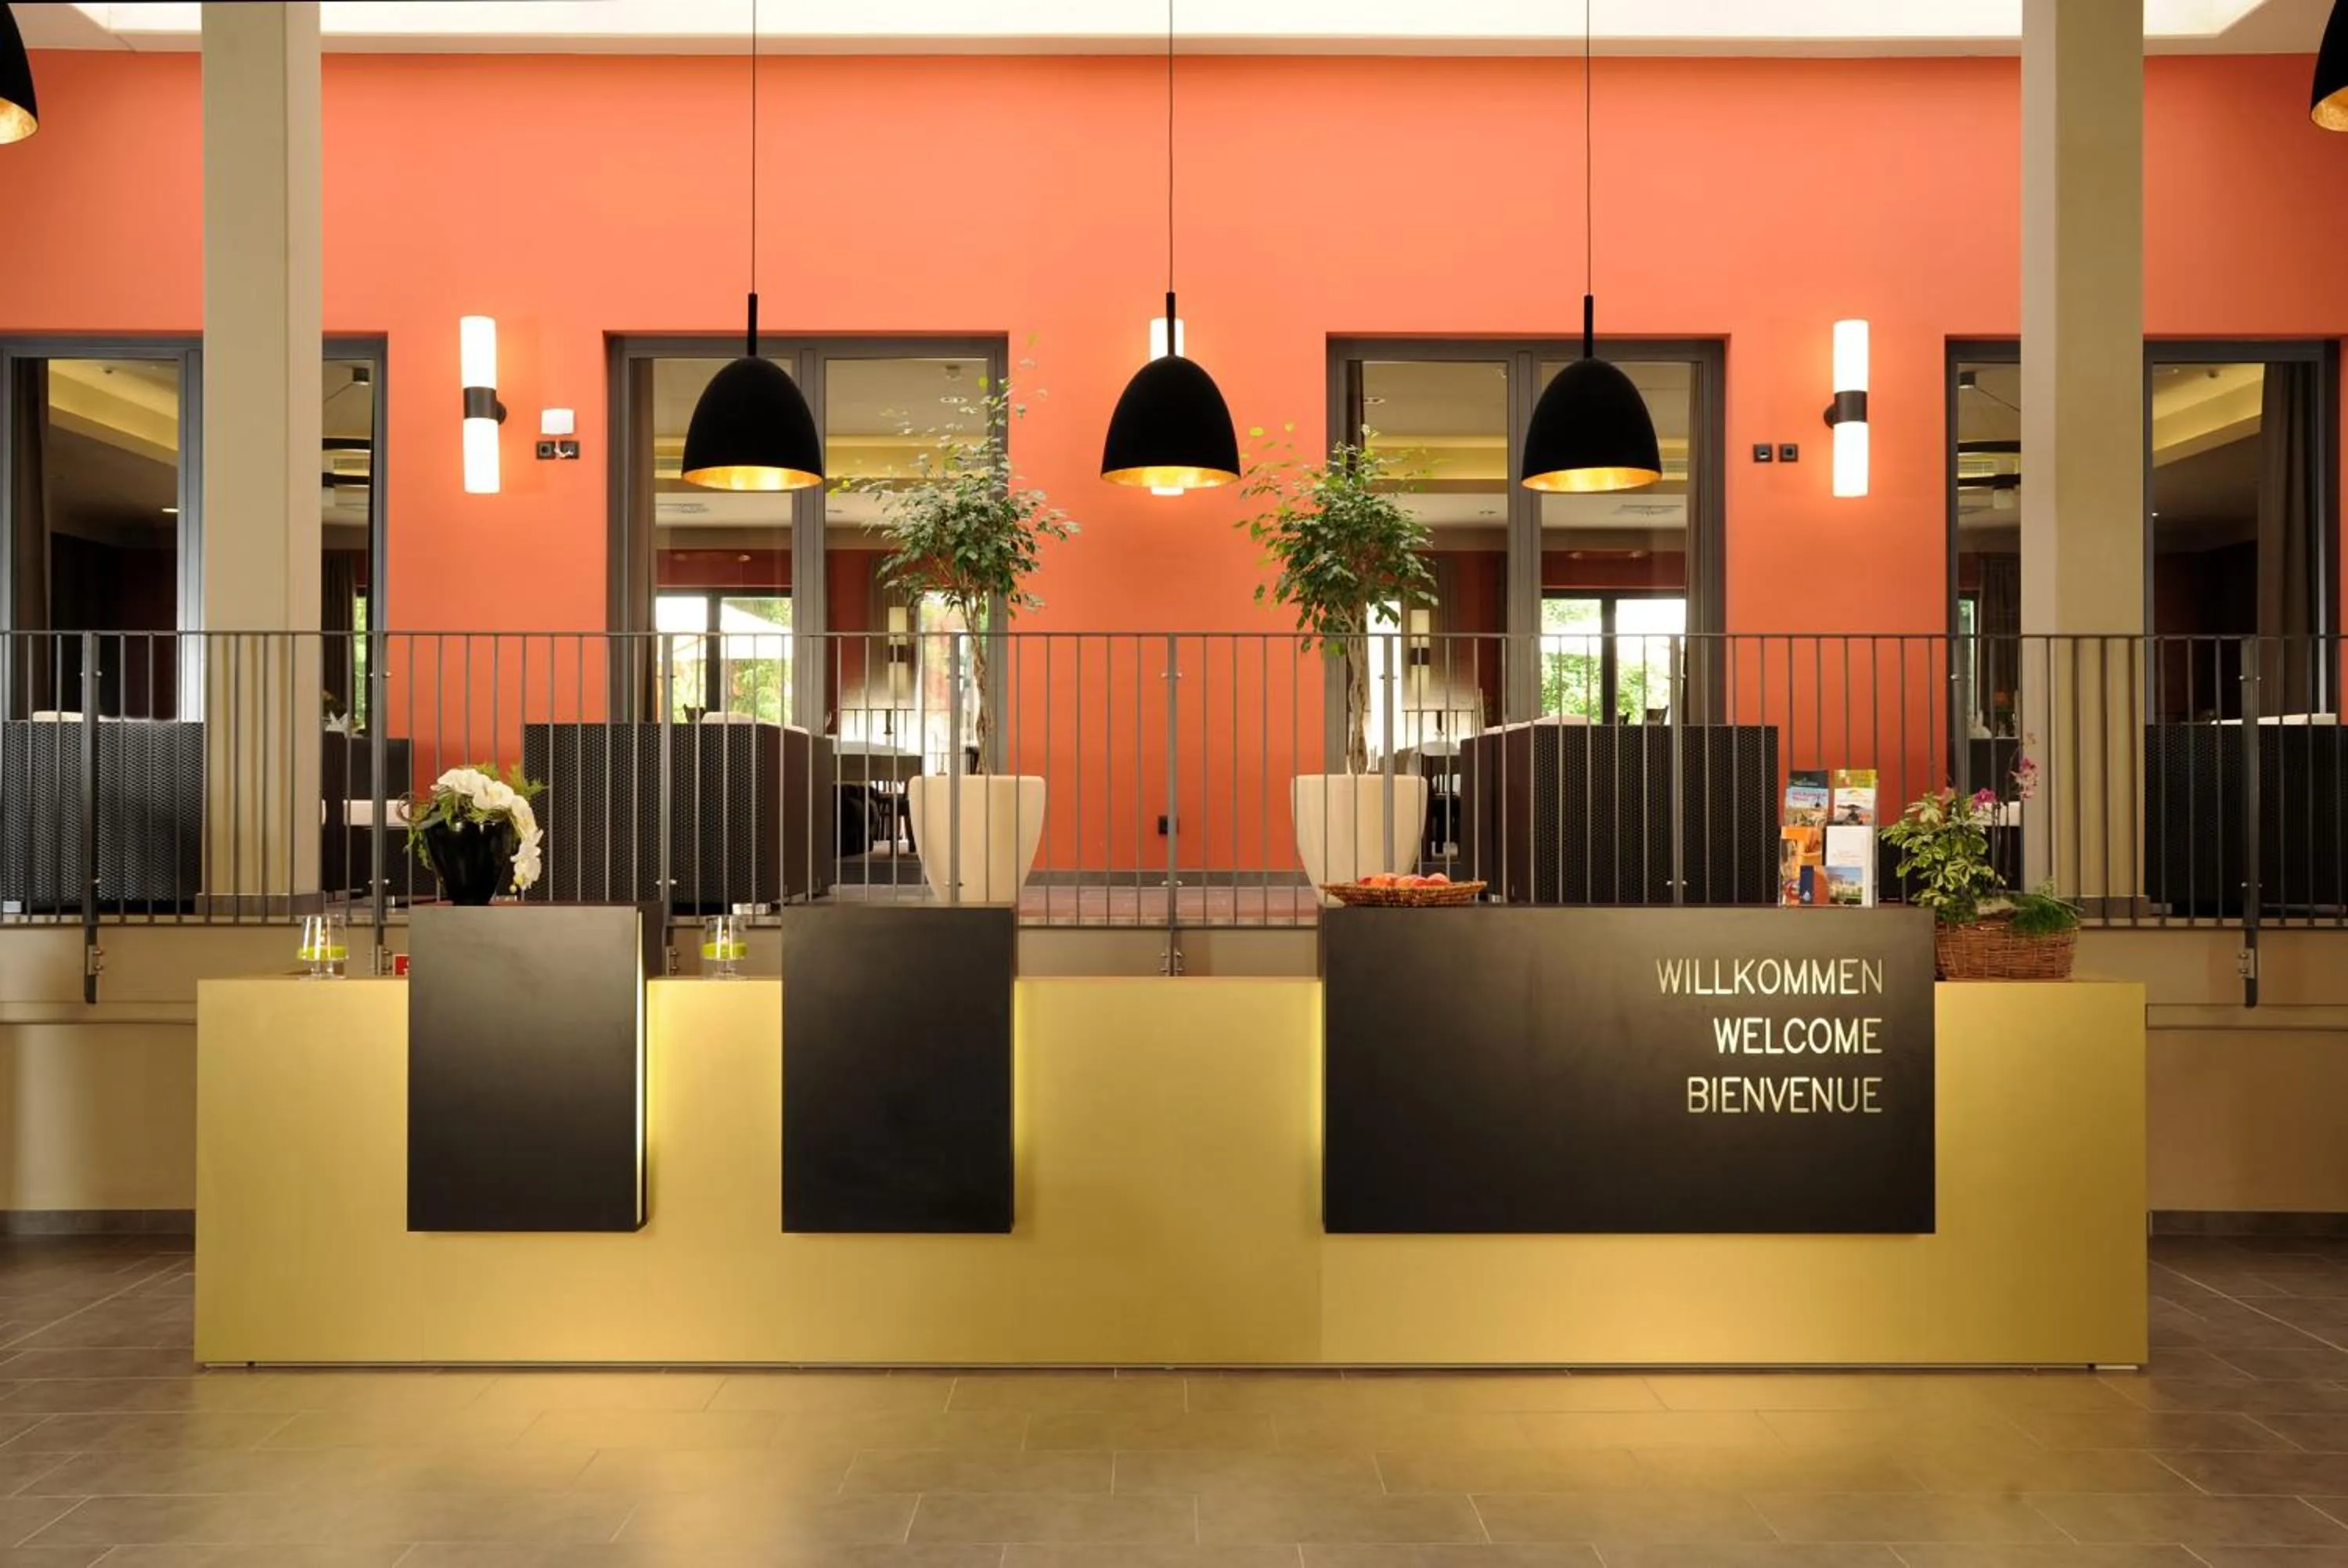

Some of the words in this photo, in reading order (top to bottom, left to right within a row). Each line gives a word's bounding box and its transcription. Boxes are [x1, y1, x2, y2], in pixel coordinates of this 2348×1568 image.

[1656, 958, 1882, 994] WILLKOMMEN
[1713, 1017, 1882, 1053] WELCOME
[1687, 1076, 1882, 1113] BIENVENUE
